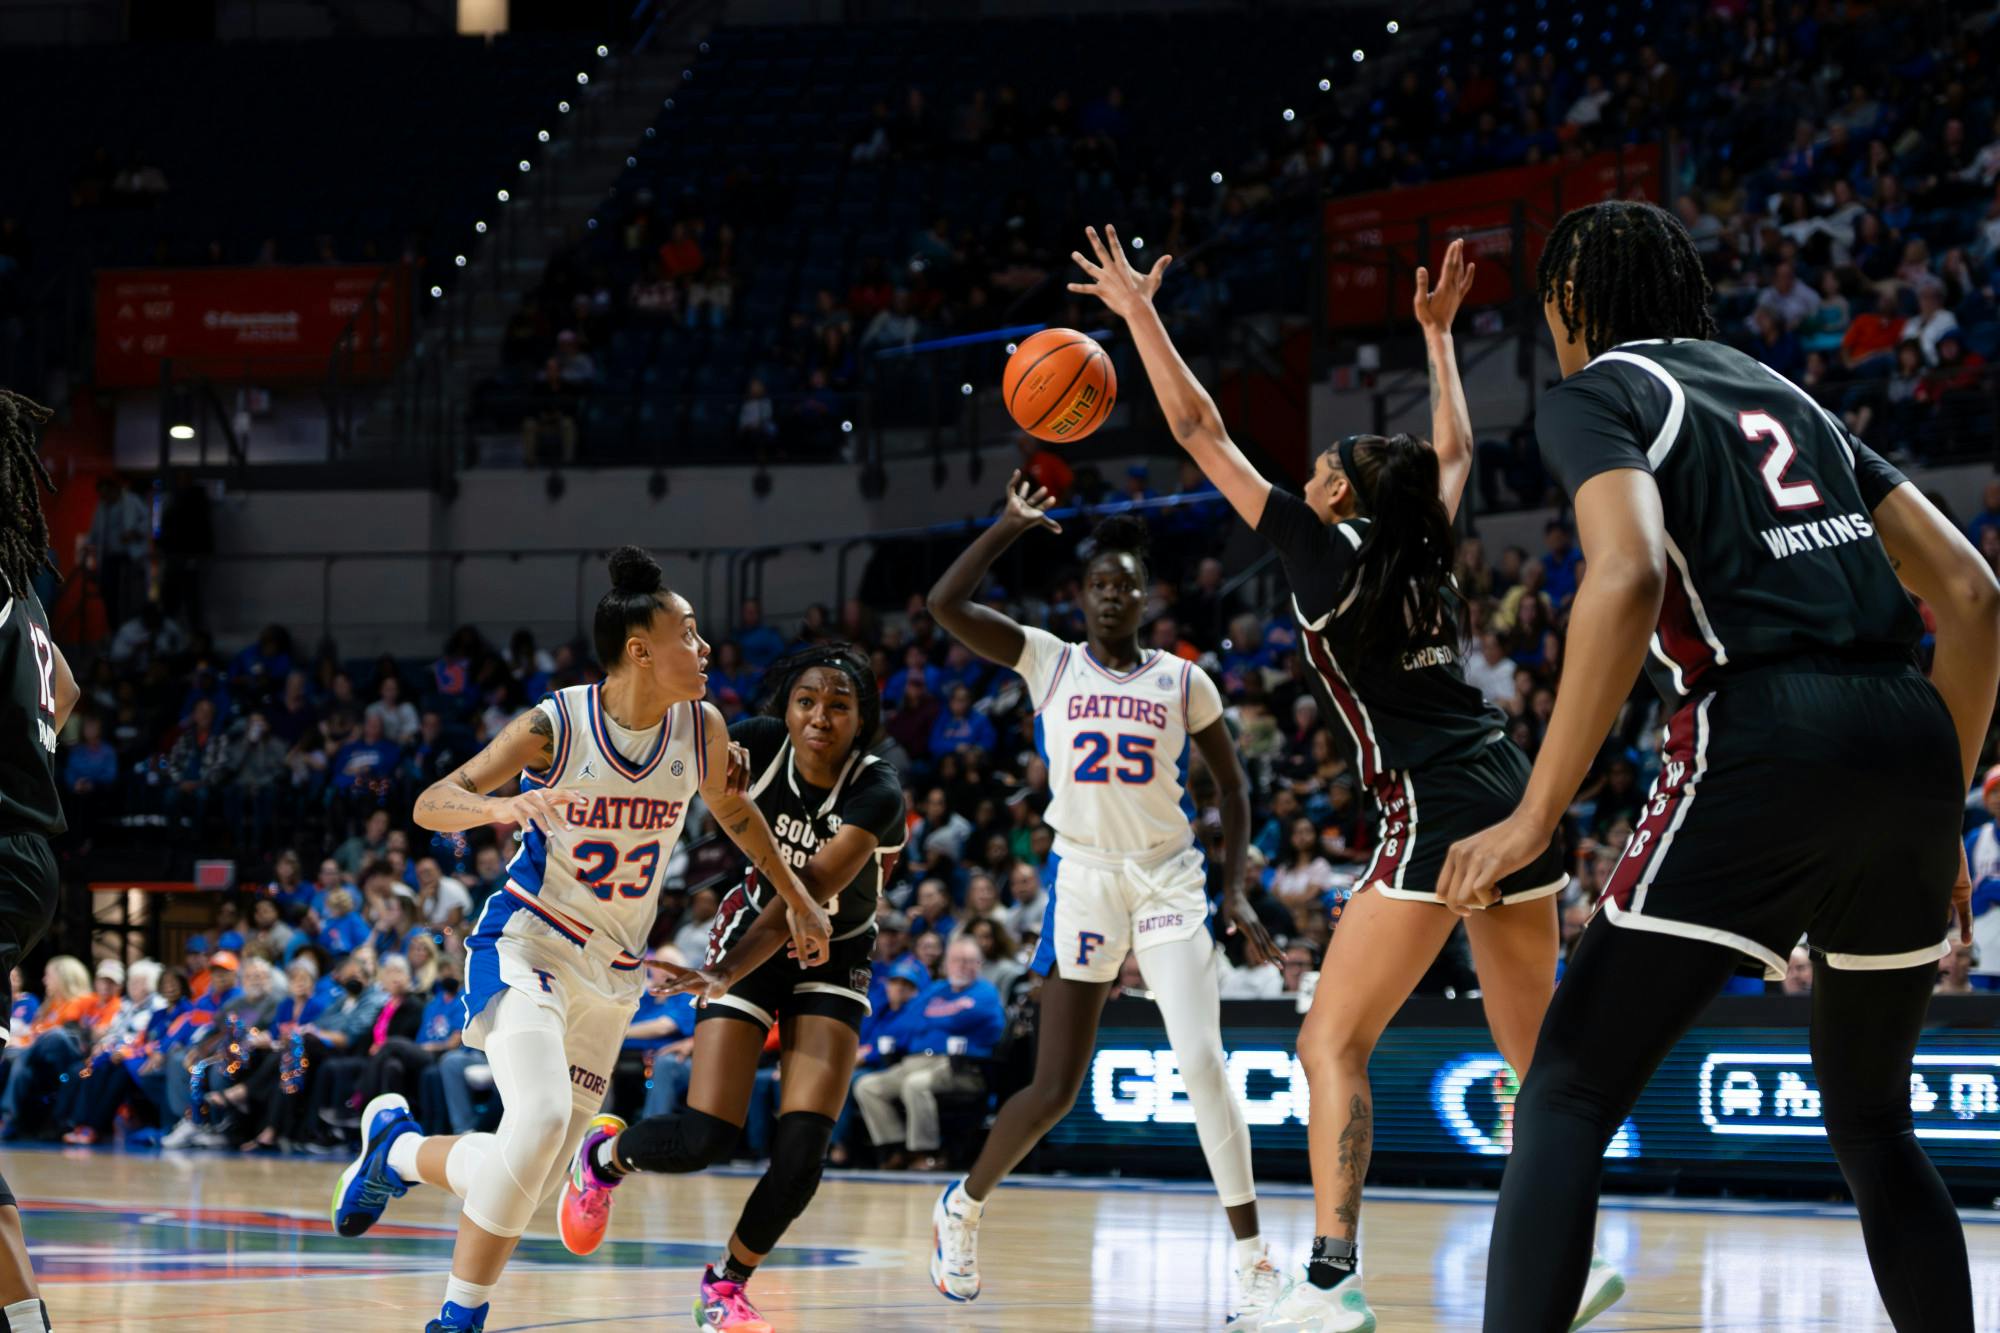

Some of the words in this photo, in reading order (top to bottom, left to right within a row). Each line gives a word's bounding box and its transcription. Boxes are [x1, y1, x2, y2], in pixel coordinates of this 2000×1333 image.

[1738, 408, 1825, 511] 2
[1760, 513, 1873, 560] WATKINS
[1068, 694, 1168, 730] GATORS
[1073, 731, 1156, 784] 25
[566, 797, 683, 830] GATORS
[774, 813, 832, 854] SOU
[573, 839, 660, 901] 23
[1138, 914, 1184, 934] GATORS
[1076, 931, 1105, 966] F
[568, 1064, 607, 1096] ATORS
